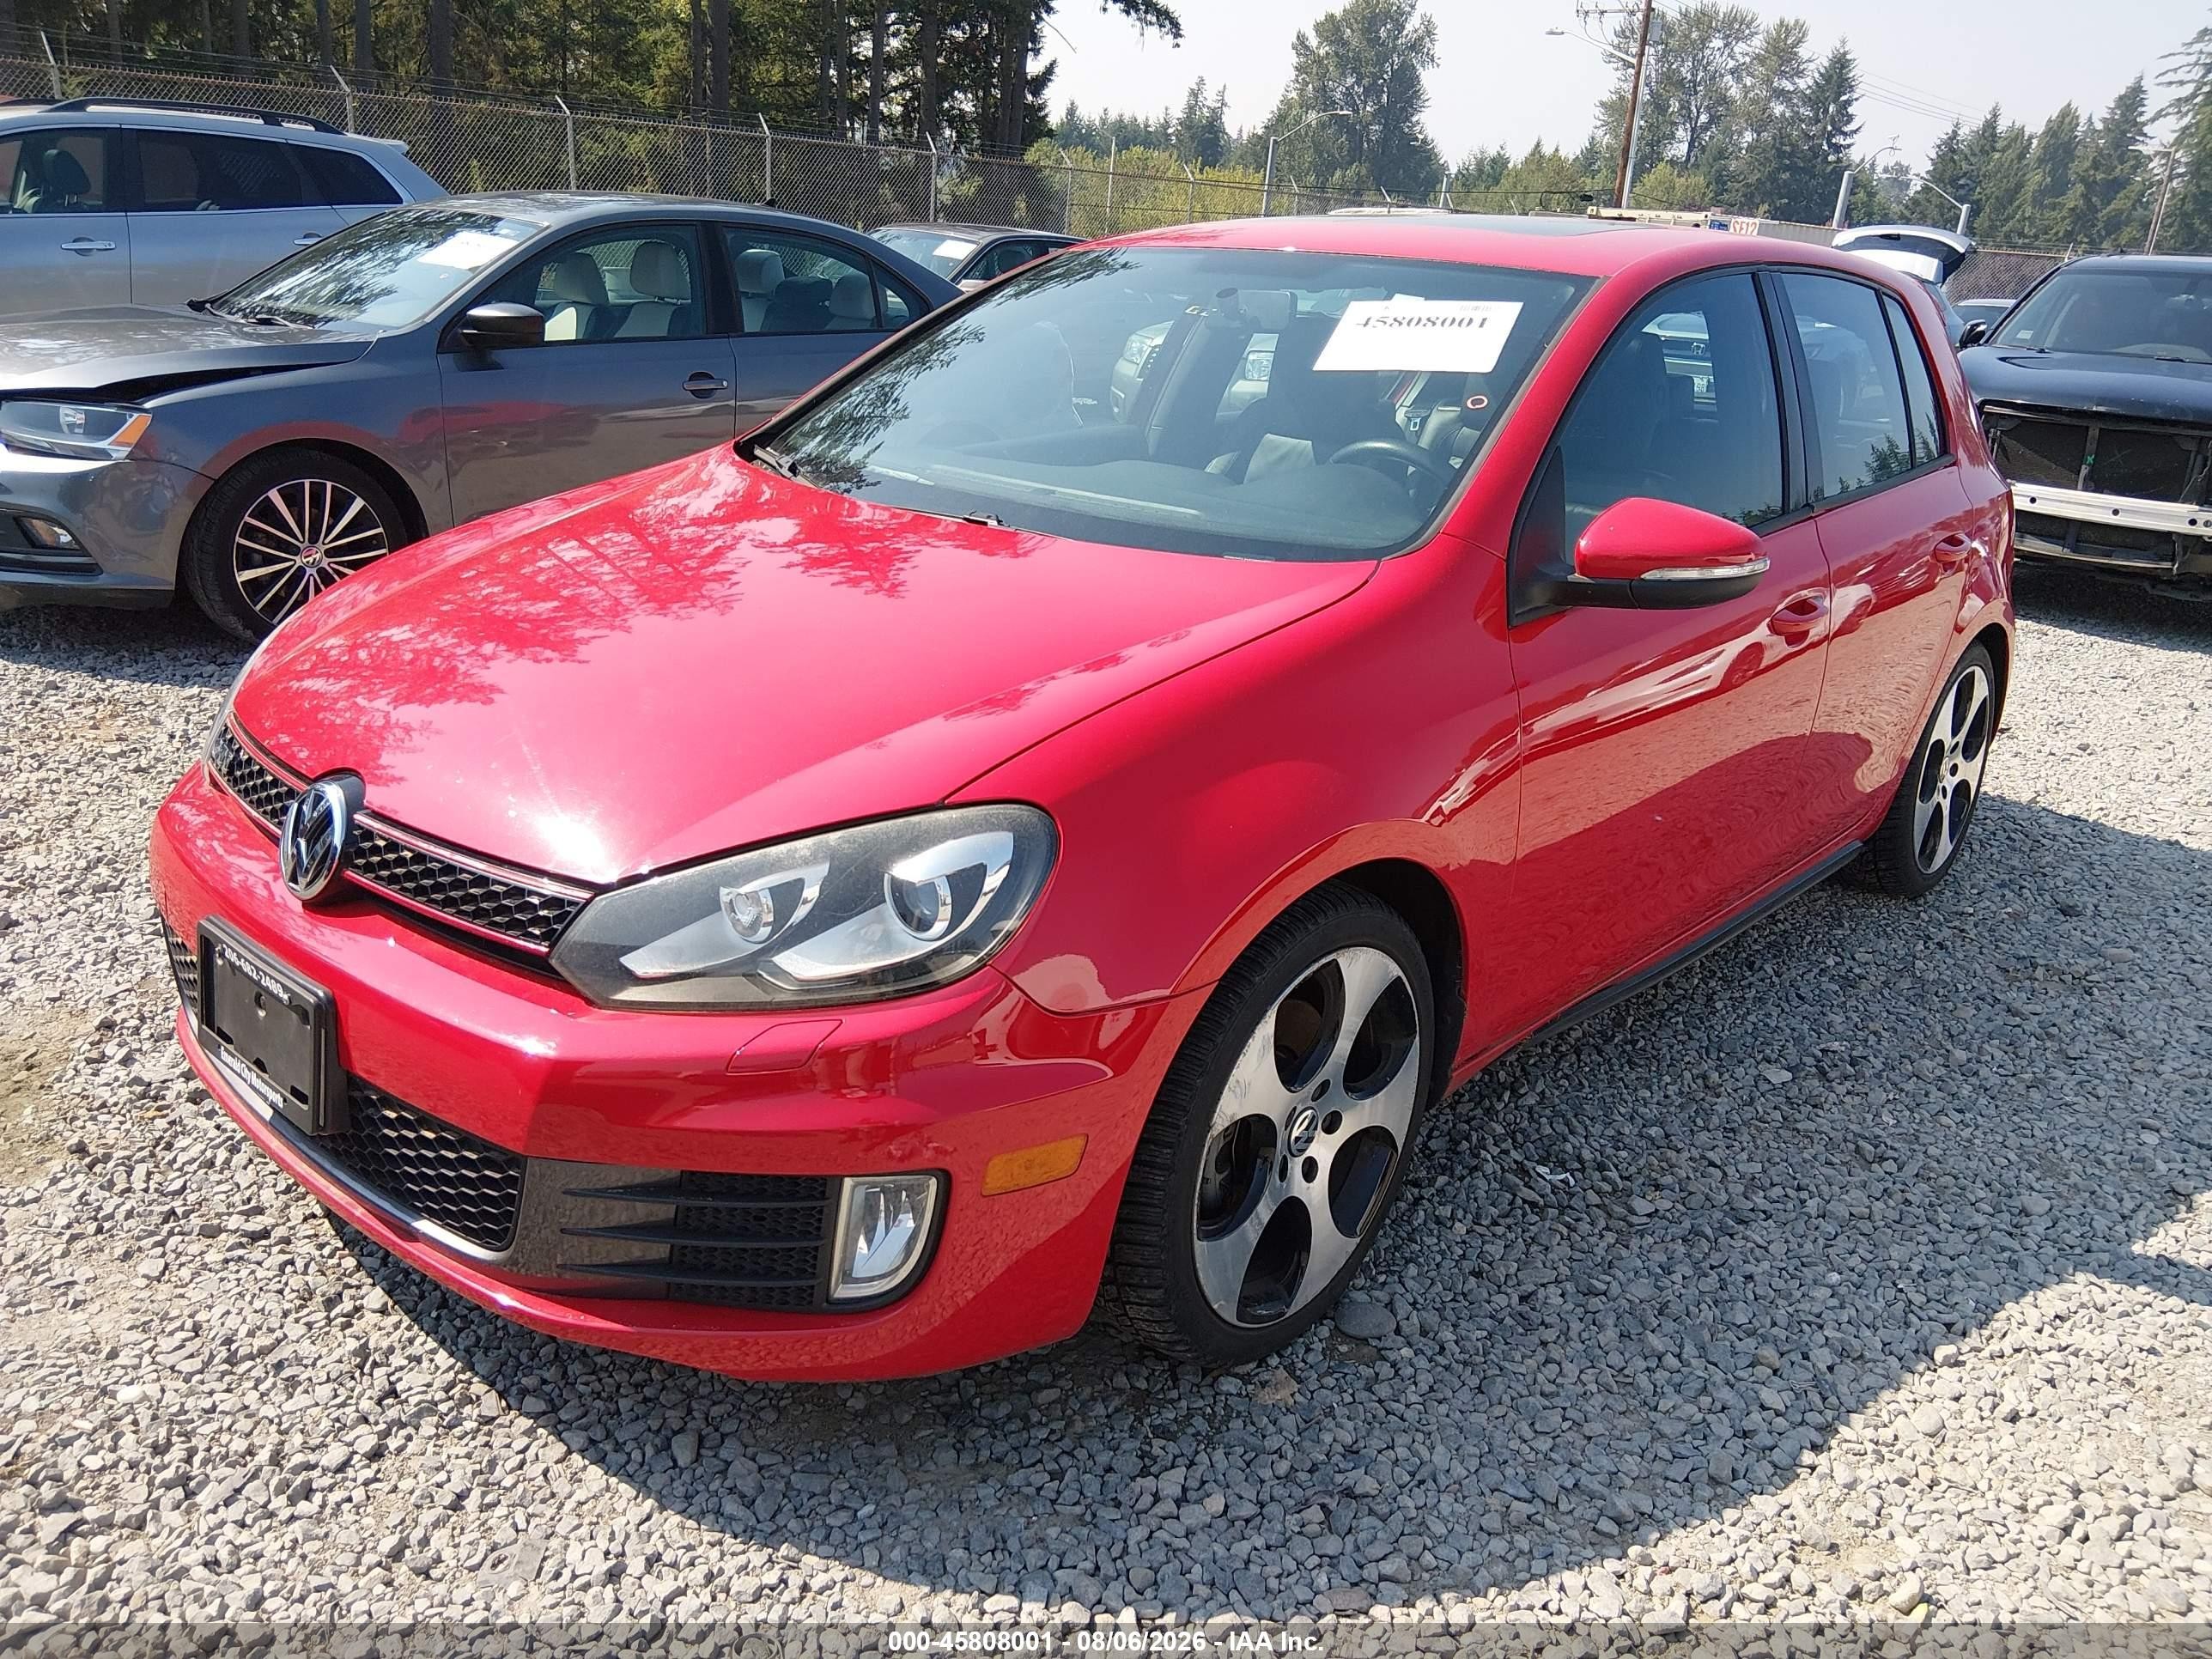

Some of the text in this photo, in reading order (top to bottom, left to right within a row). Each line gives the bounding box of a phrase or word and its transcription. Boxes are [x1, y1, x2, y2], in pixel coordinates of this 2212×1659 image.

[1355, 315, 1490, 329] 45808001
[222, 943, 284, 998] 206-682-2489
[220, 1045, 284, 1109] Emerald City Motorsports
